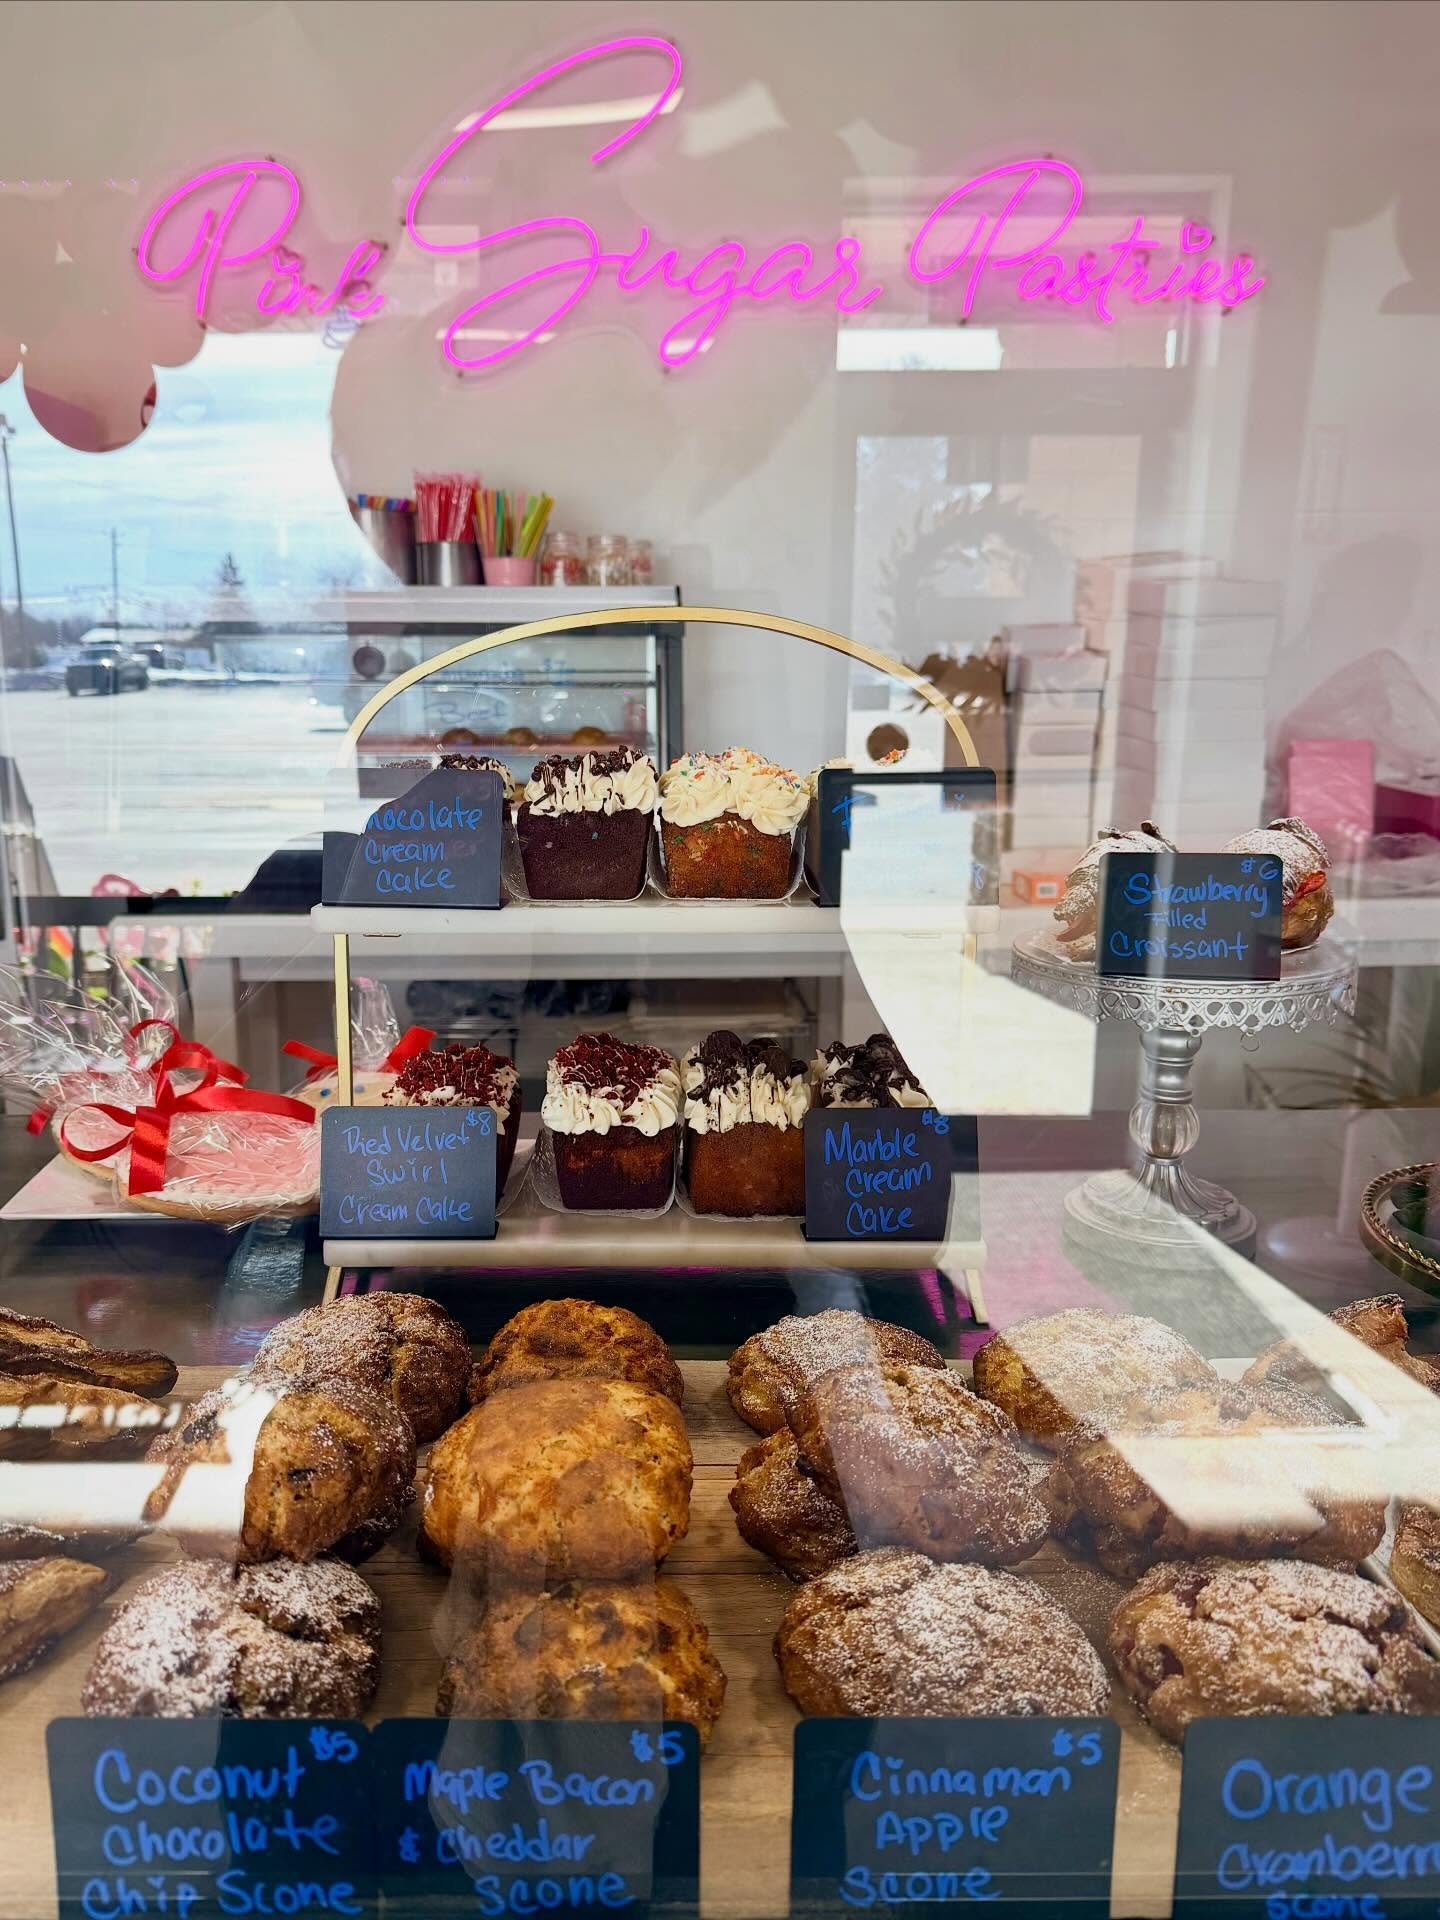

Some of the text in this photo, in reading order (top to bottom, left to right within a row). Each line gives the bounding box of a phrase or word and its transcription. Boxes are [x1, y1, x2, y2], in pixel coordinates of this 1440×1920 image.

[137, 35, 1266, 368] Pink Sugar Pastries
[367, 797, 482, 831] hocolate
[364, 839, 445, 865] Cream
[374, 867, 457, 894] Cake
[1123, 871, 1271, 919] Strawberry
[1109, 930, 1249, 961] Croissant
[397, 1121, 470, 1152] Velvet
[466, 1109, 492, 1136] $8
[823, 1121, 920, 1167] Marble
[366, 1157, 449, 1188] Swirl
[845, 1161, 932, 1199] Cream
[338, 1195, 473, 1225] Cream Cake
[845, 1201, 915, 1236] Cake
[309, 1726, 359, 1762] $5
[629, 1729, 685, 1766] $5
[1052, 1728, 1103, 1766] $5
[94, 1745, 305, 1814] Coconut
[404, 1759, 655, 1814] Maple Bacon
[1222, 1758, 1434, 1833] Orange
[103, 1808, 340, 1866] Chocolate
[436, 1818, 596, 1863] Cheddar
[876, 1805, 1009, 1855] Apple
[1217, 1833, 1440, 1890] Cranberr
[82, 1869, 362, 1920] Chip Scone
[475, 1872, 636, 1916] Scone
[839, 1865, 1003, 1908] Scone
